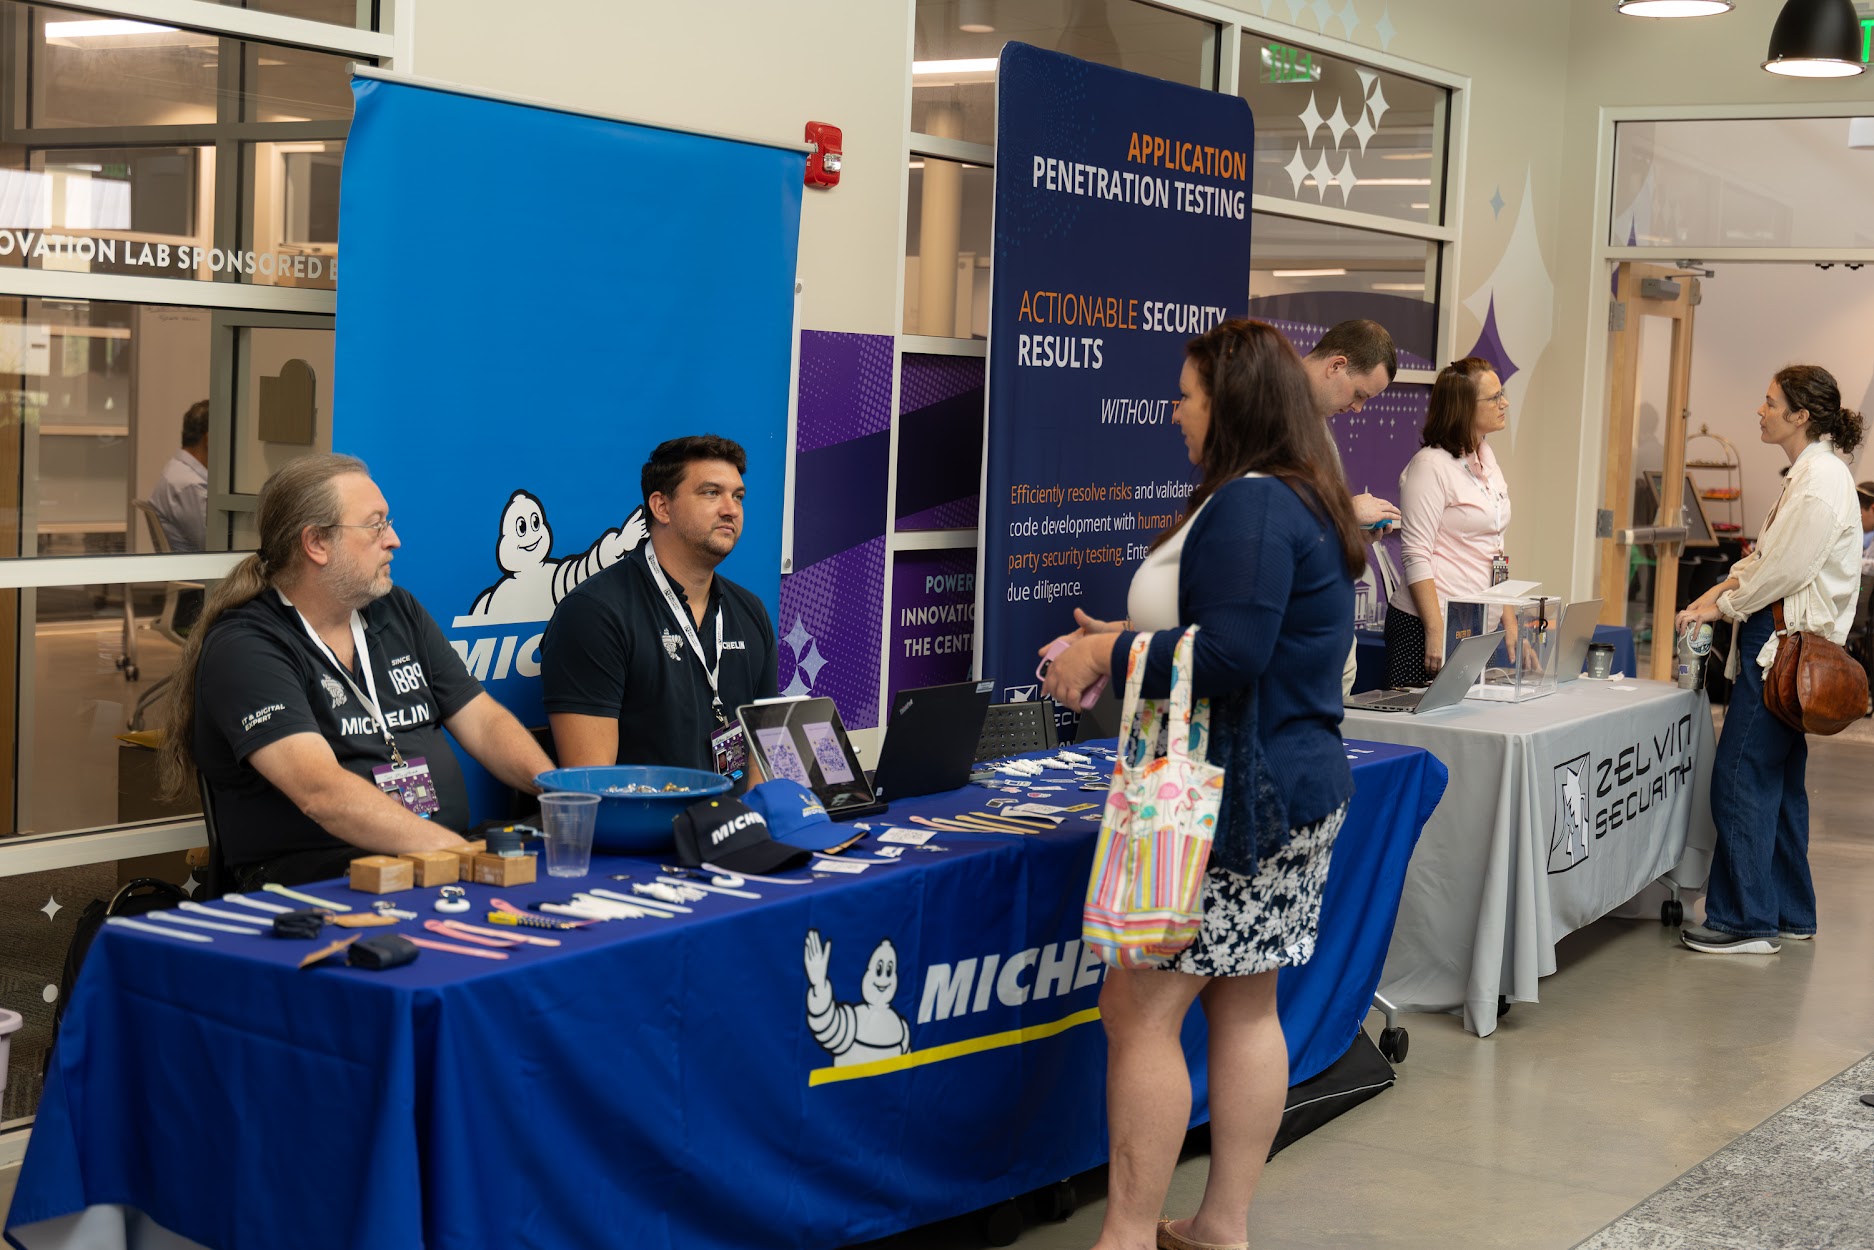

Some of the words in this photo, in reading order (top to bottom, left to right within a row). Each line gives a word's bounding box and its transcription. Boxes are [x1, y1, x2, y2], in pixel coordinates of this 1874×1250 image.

[1127, 131, 1247, 181] APPLICATION
[1033, 155, 1169, 209] PENETRATION
[1174, 181, 1246, 220] TESTING
[124, 241, 171, 268] LAB
[177, 245, 323, 280] SPONSORED
[1018, 290, 1138, 330] ACTIONABLE
[1142, 300, 1227, 335] SECURITY
[1018, 334, 1104, 369] RESULTS
[1101, 398, 1169, 425] WITHOUT
[1010, 483, 1065, 508] Efficiently
[1067, 482, 1107, 502] resolve
[1108, 481, 1133, 501] risks
[1134, 480, 1155, 500] and
[1155, 479, 1194, 499] validate
[1009, 516, 1039, 537] code
[1041, 513, 1112, 538] development
[1113, 511, 1136, 531] with
[1137, 511, 1173, 530] human
[1008, 551, 1041, 576] party
[1041, 546, 1086, 570] security
[1085, 544, 1125, 567] testing.
[1126, 542, 1152, 561] Ente
[925, 573, 974, 594] POWER
[1007, 582, 1031, 602] due
[1033, 579, 1083, 604] diligence.
[722, 640, 746, 650] CHELIN
[904, 638, 931, 658] THE
[934, 633, 974, 655] CENT
[391, 655, 411, 667] SINCE
[388, 662, 429, 696] 1889
[241, 716, 248, 726] IT
[255, 703, 286, 719] DIGITAL
[245, 712, 272, 732] EXPERT
[1595, 756, 1692, 841] SECURITY
[917, 938, 1110, 1025] MICHE
